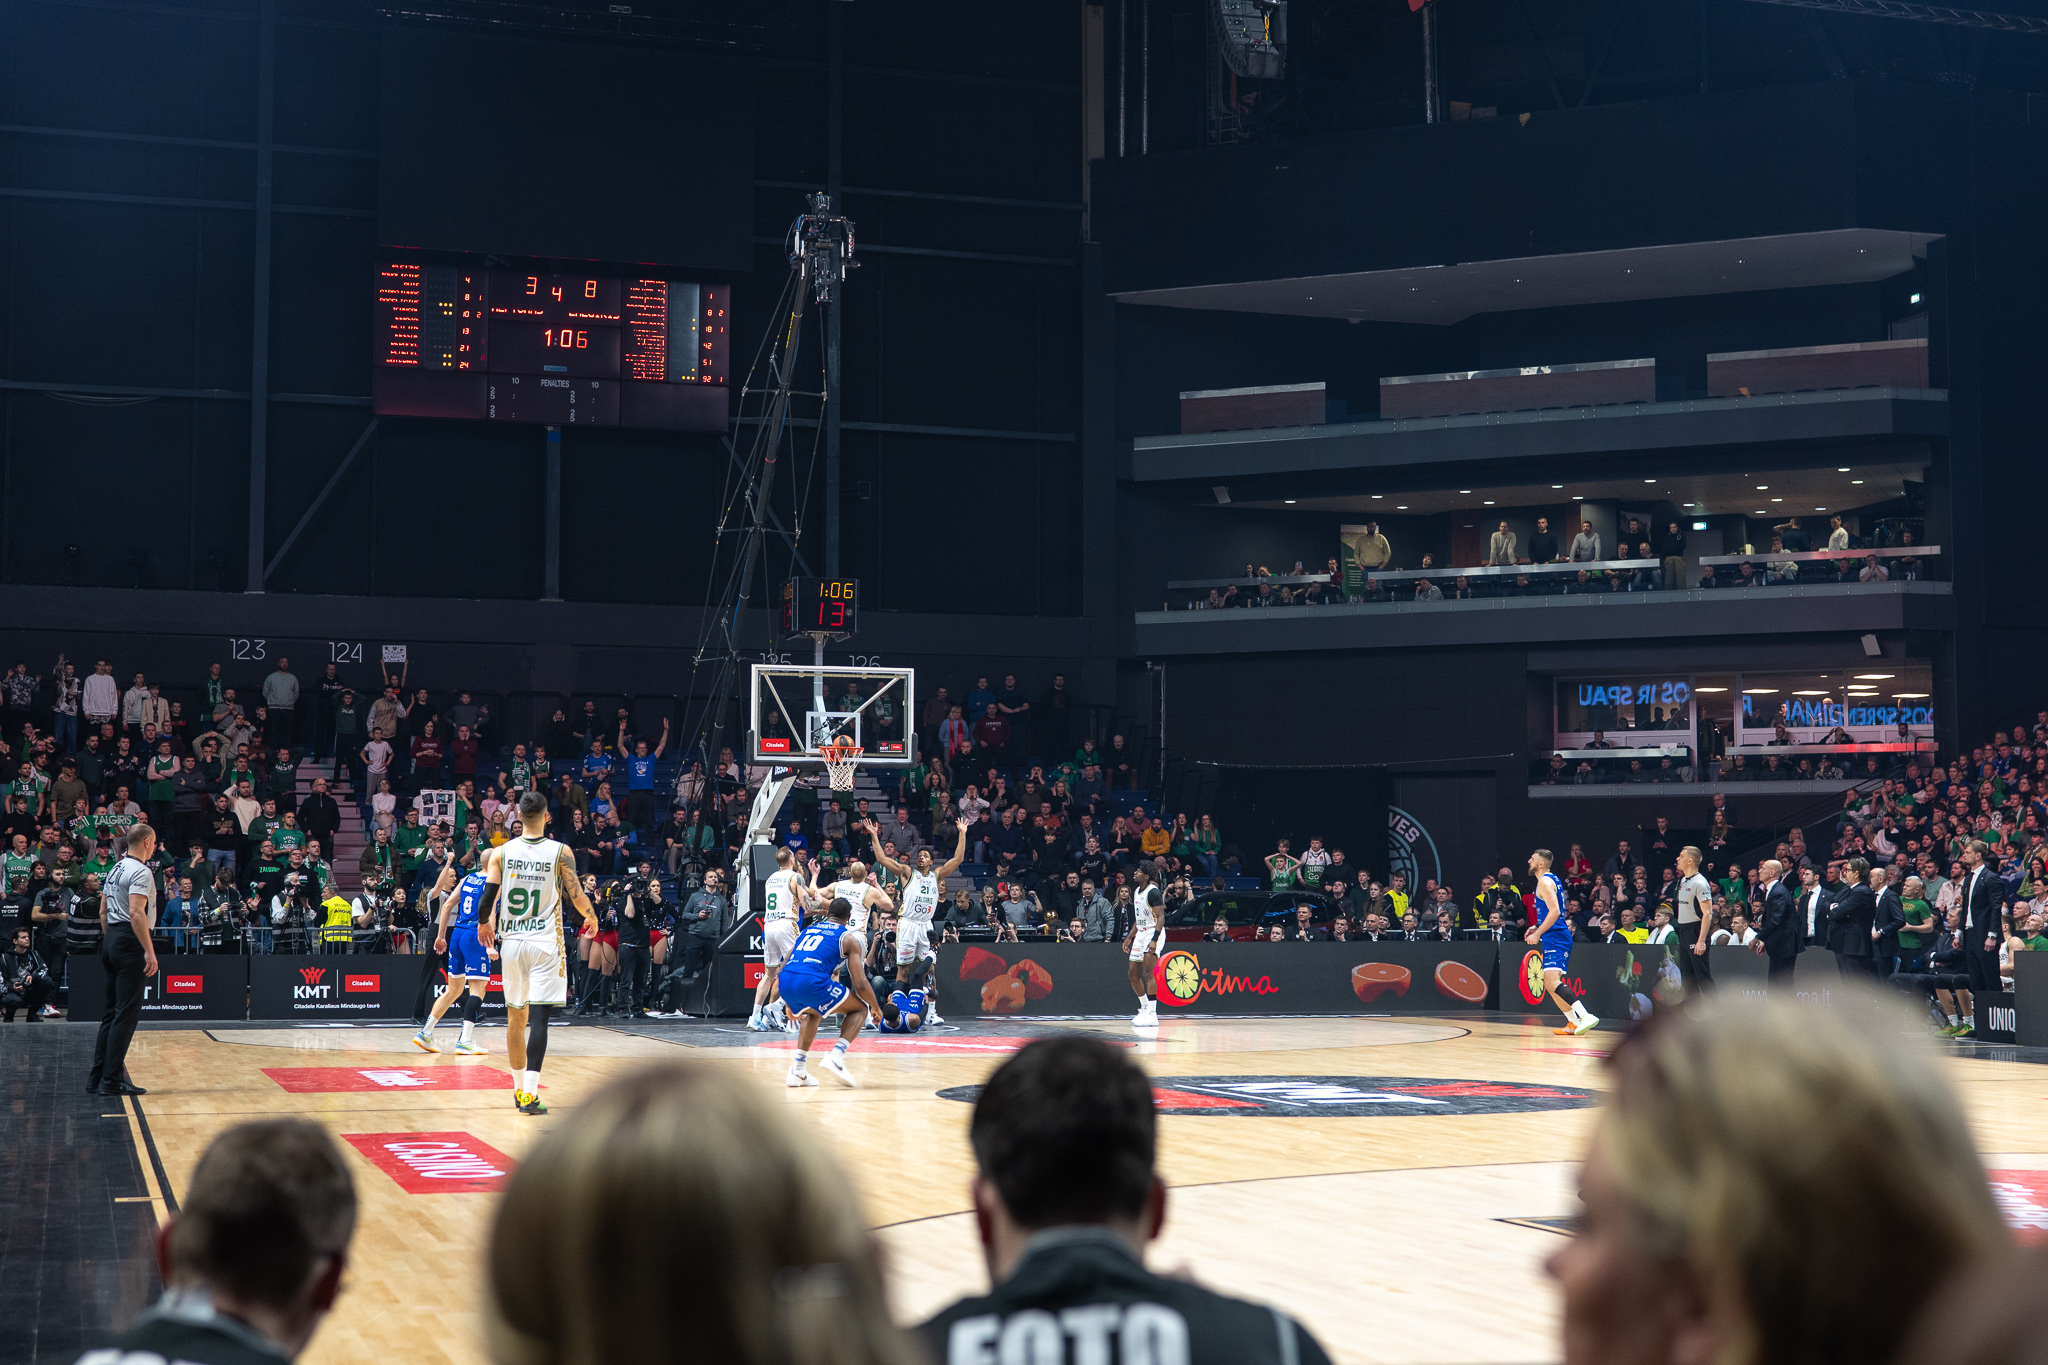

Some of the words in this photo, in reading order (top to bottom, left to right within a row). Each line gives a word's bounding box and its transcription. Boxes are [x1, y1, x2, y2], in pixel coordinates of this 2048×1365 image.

[526, 276, 538, 294] 3
[585, 280, 596, 298] 8
[552, 287, 562, 301] 4
[545, 329, 588, 348] 1:06
[541, 379, 570, 388] PENALTIES
[820, 582, 854, 599] 1:06
[819, 602, 844, 626] 13
[230, 638, 266, 660] 123
[328, 642, 362, 663] 124
[508, 859, 551, 872] SIRVYDIS
[921, 886, 929, 894] 21
[463, 896, 472, 914] 8
[508, 888, 540, 917] 91
[768, 893, 777, 910] 8
[796, 934, 824, 951] 10
[481, 963, 486, 973] 8
[294, 986, 331, 999] KMT
[830, 987, 842, 999] 10
[383, 1142, 506, 1179] CASINO
